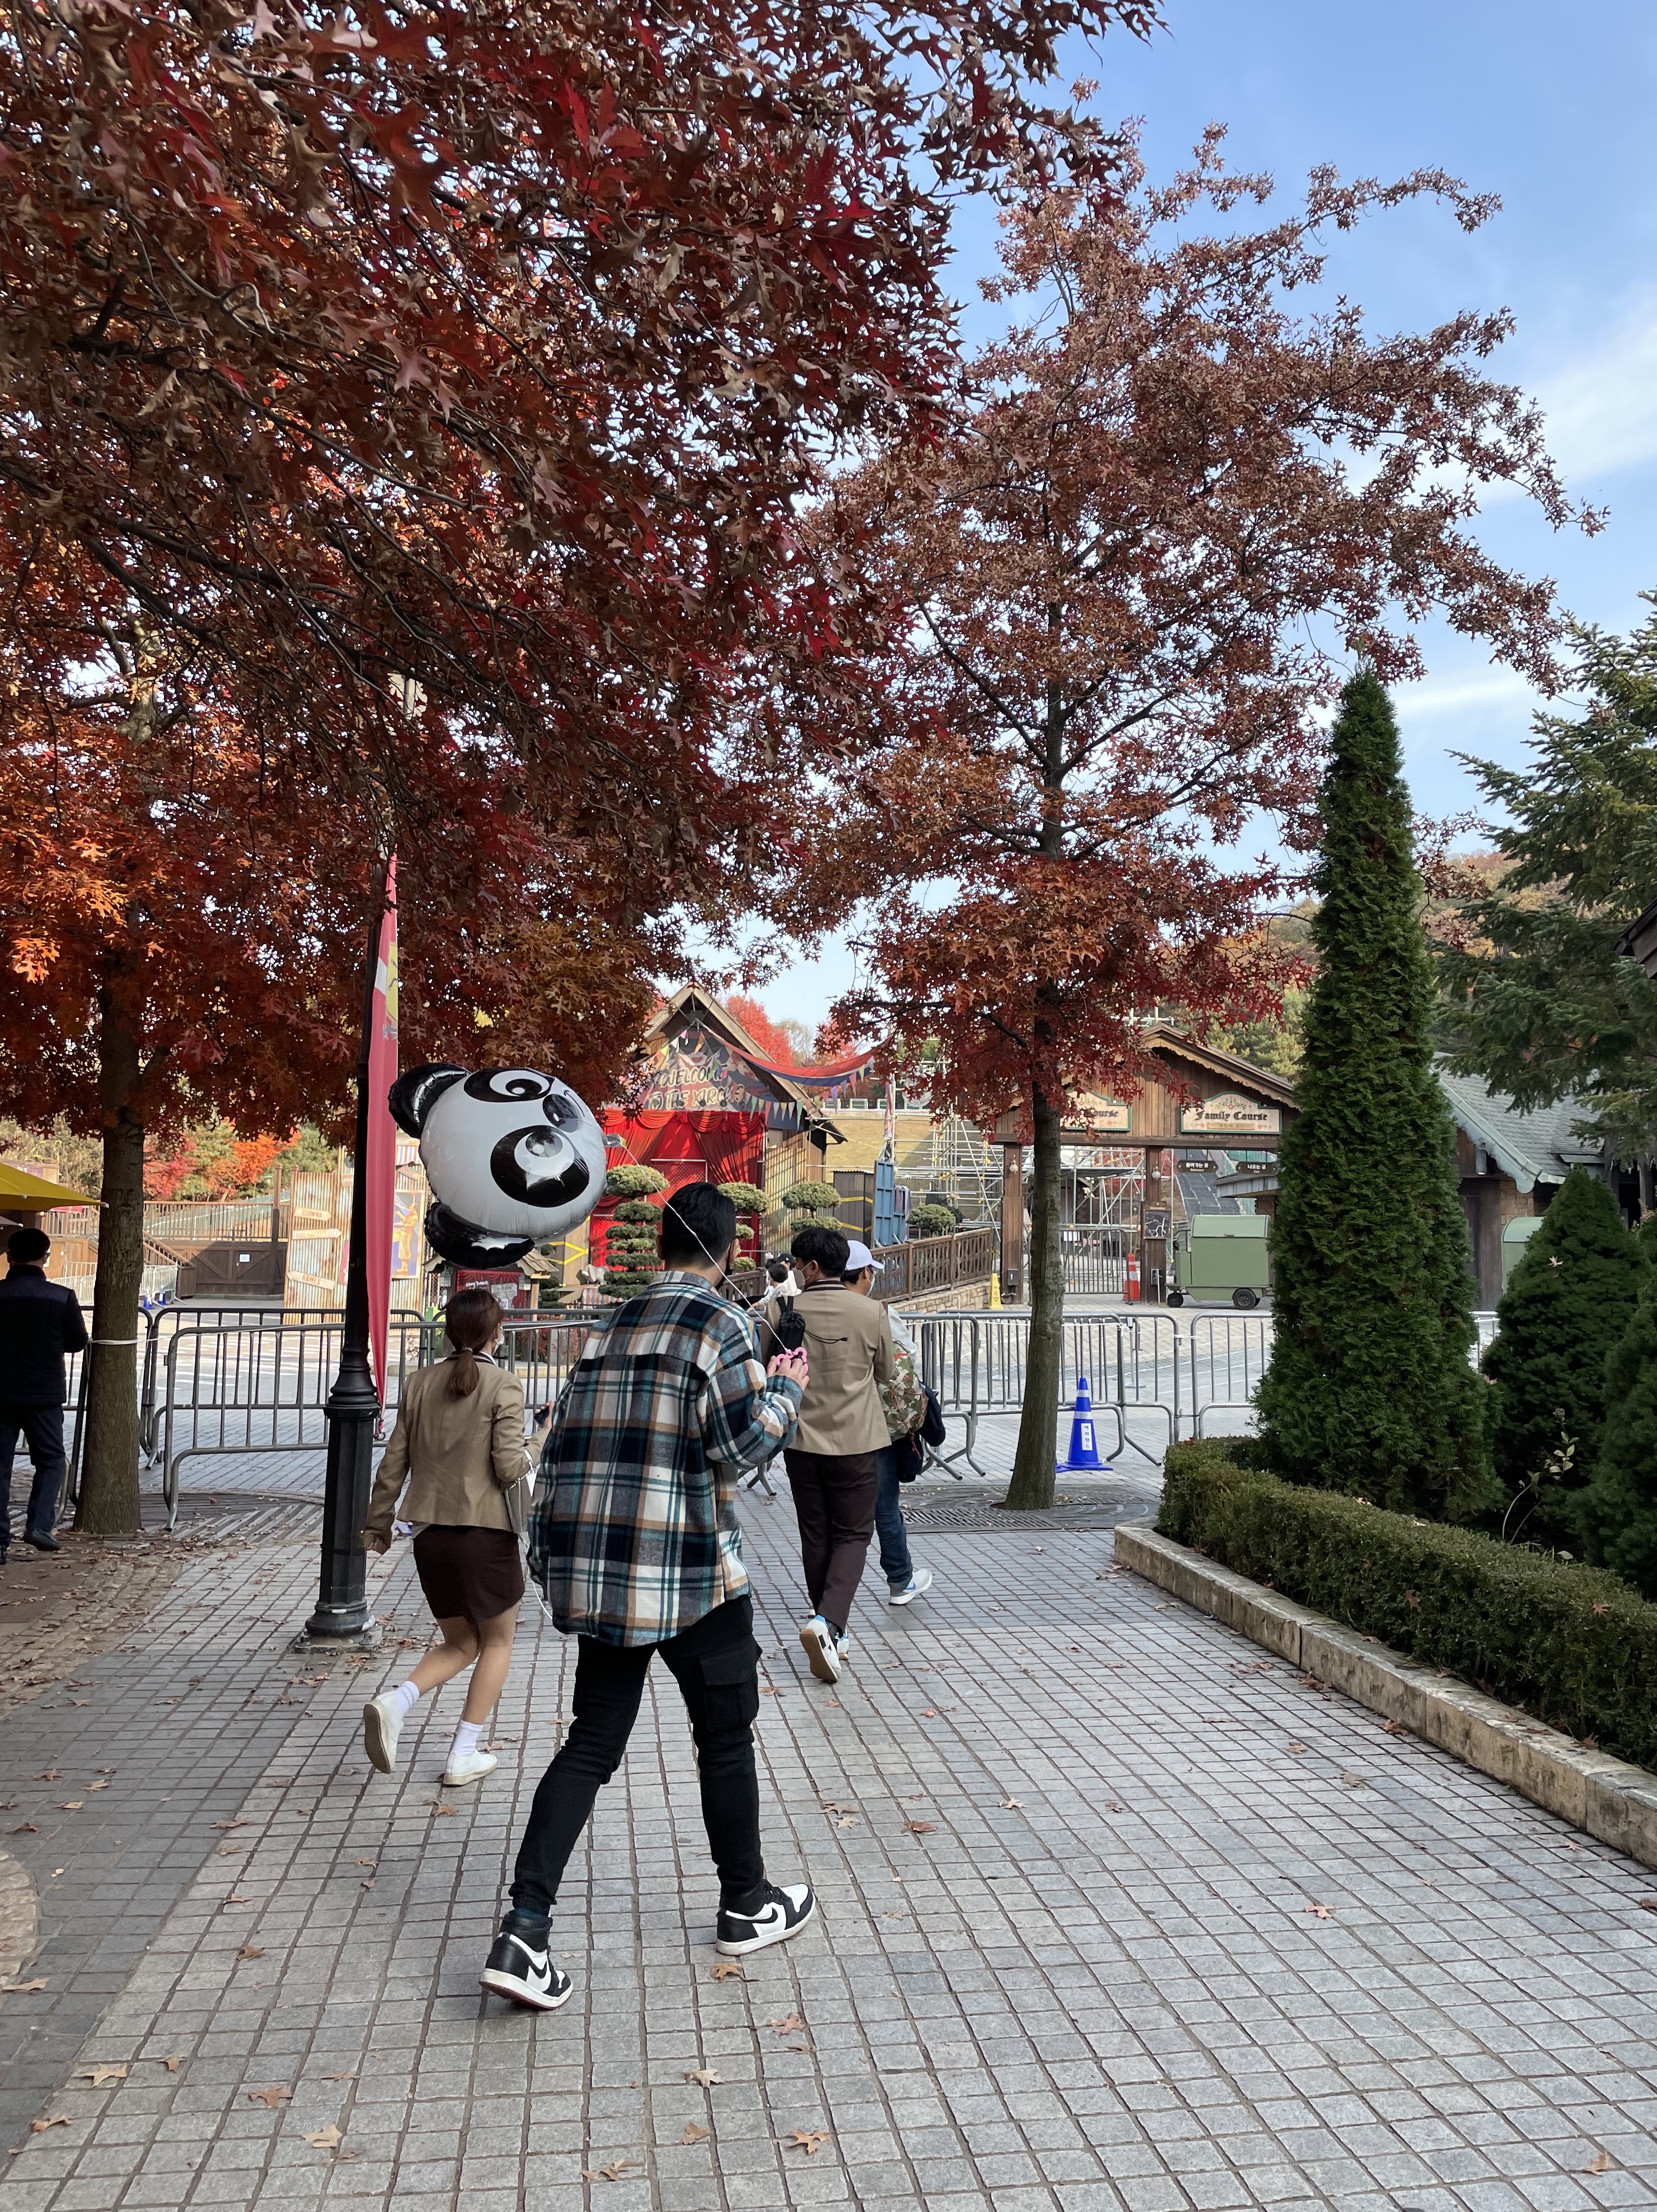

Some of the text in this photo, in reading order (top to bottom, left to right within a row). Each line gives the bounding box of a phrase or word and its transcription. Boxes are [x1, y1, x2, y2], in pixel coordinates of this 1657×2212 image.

[665, 1089, 690, 1110] THE
[1195, 1110, 1268, 1121] Family Course
[302, 1210, 323, 1218] CLOWNS
[301, 1274, 321, 1285] GAMES
